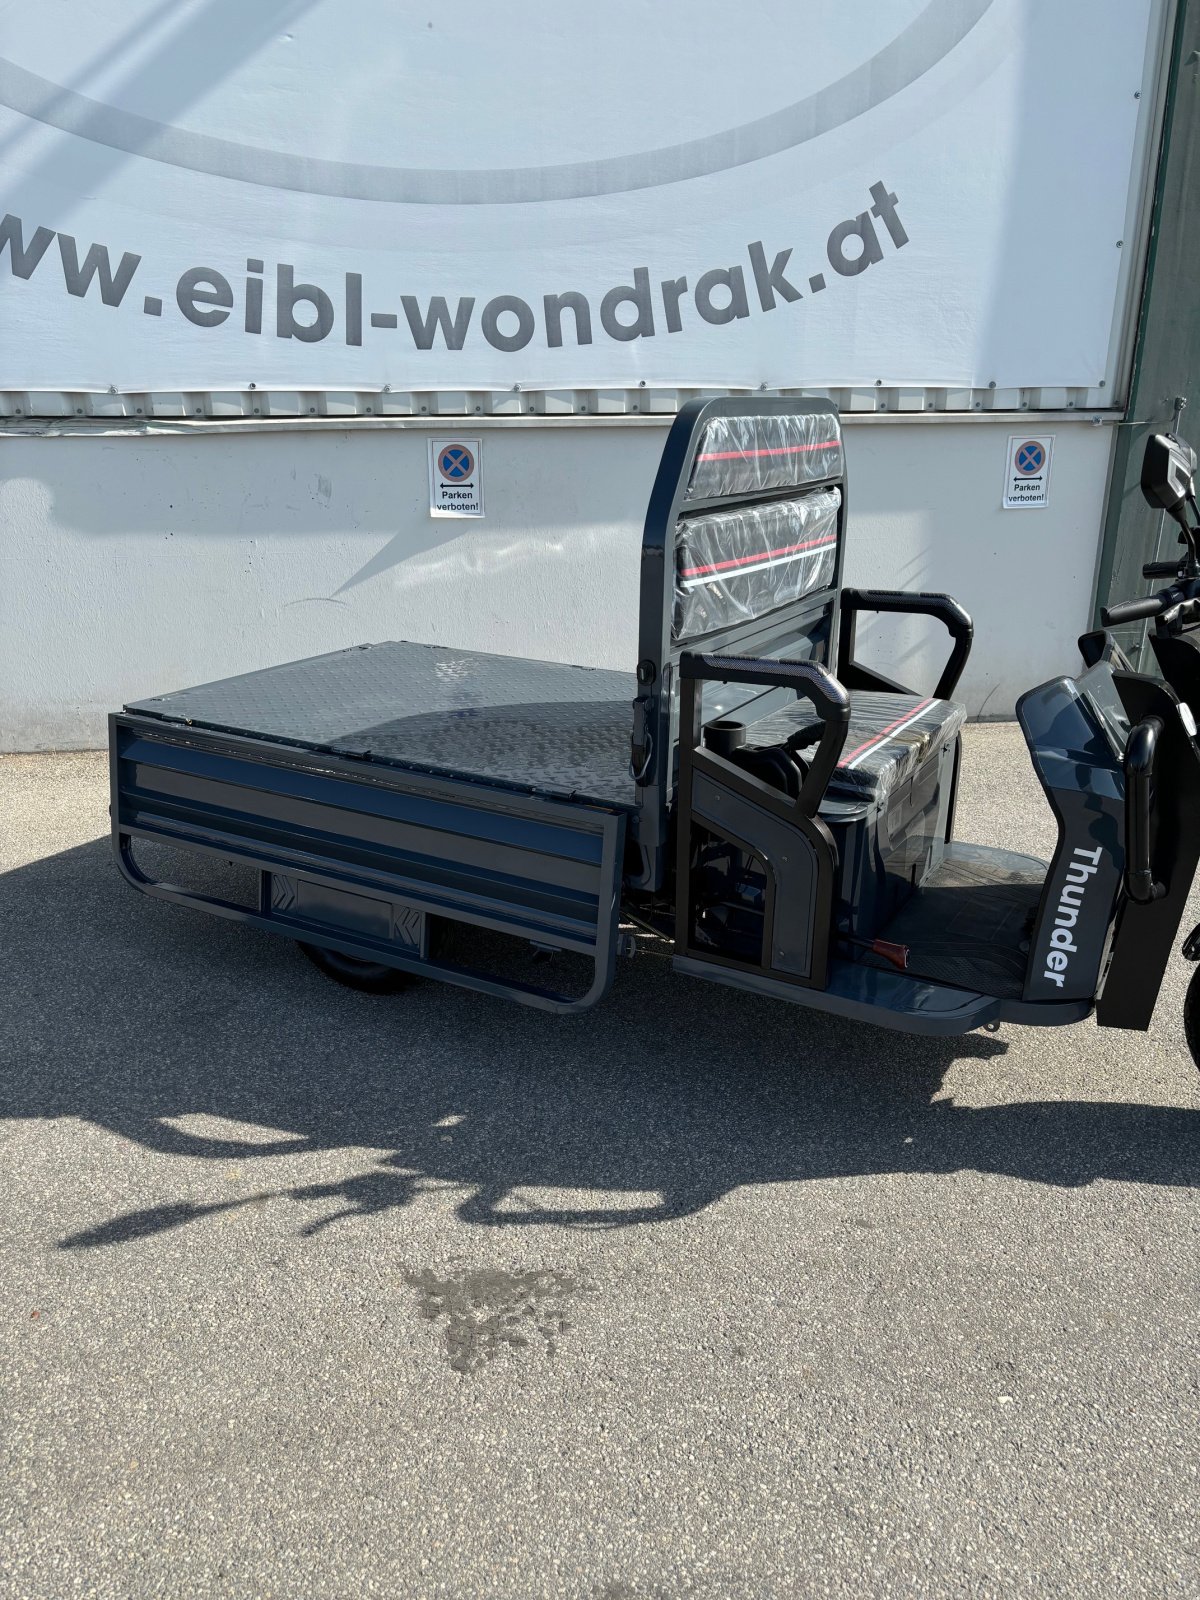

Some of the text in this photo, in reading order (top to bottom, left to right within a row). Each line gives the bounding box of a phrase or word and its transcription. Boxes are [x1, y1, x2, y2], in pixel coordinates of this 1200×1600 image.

[442, 491, 473, 499] Parken
[1008, 494, 1044, 502] verboten!
[437, 502, 479, 511] verboten!
[1044, 847, 1102, 988] Thunder
